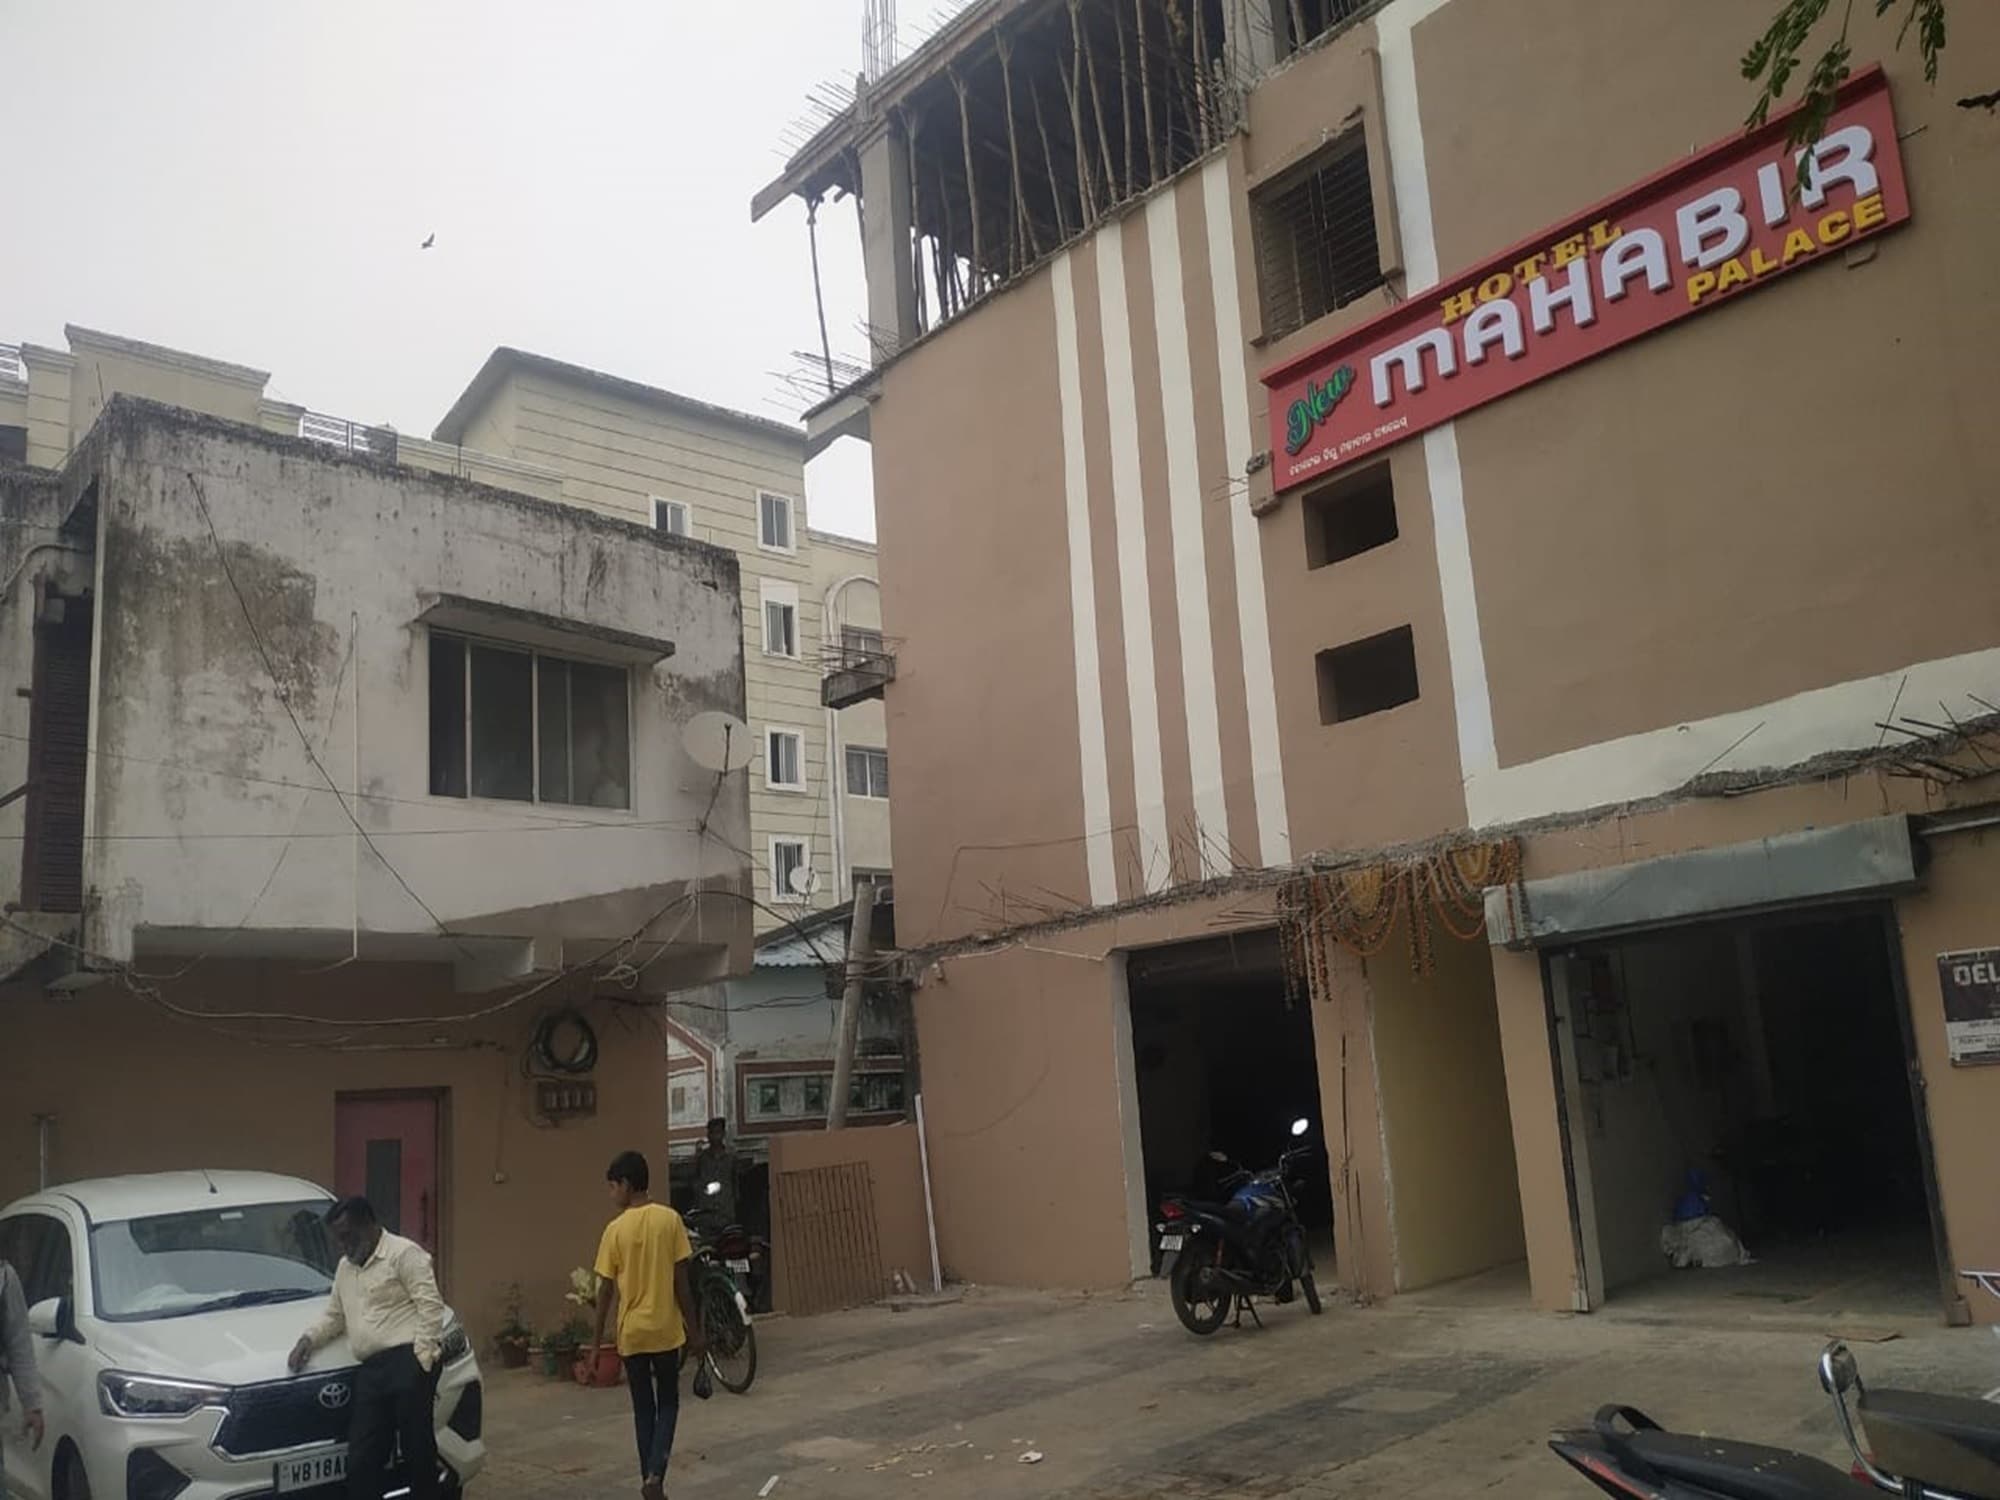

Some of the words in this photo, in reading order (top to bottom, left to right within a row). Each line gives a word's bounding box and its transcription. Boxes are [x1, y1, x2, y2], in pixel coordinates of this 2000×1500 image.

[1285, 364, 1355, 456] New
[1370, 125, 1881, 409] MAHABIR
[1441, 220, 1625, 325] HOTEL
[1686, 193, 1886, 304] PALACE
